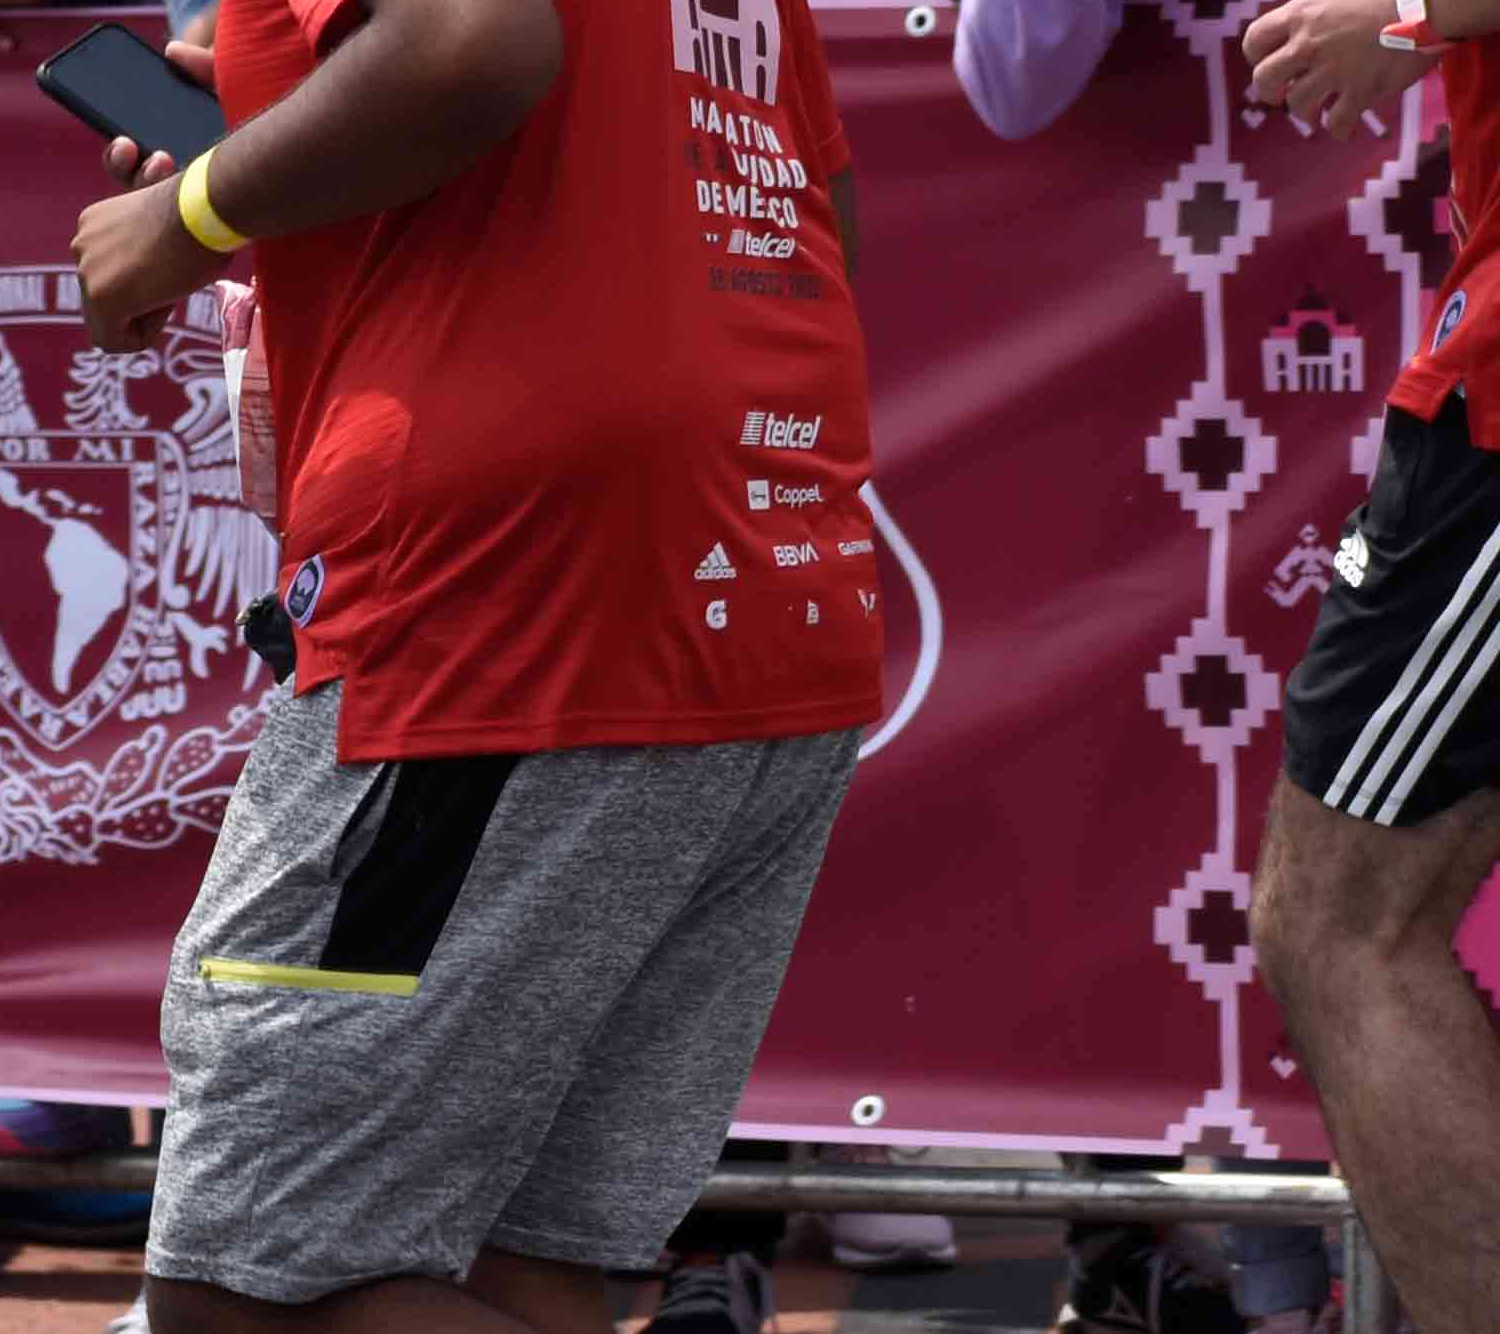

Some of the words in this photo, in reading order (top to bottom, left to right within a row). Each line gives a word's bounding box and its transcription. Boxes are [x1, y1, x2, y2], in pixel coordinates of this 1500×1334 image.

[689, 95, 783, 154] MAATON
[695, 179, 725, 214] DE
[725, 184, 799, 229] MECO
[744, 231, 796, 259] telcel
[764, 412, 820, 449] telcel
[73, 438, 135, 462] MI
[774, 482, 824, 508] Coppel
[772, 541, 820, 567] BBVA
